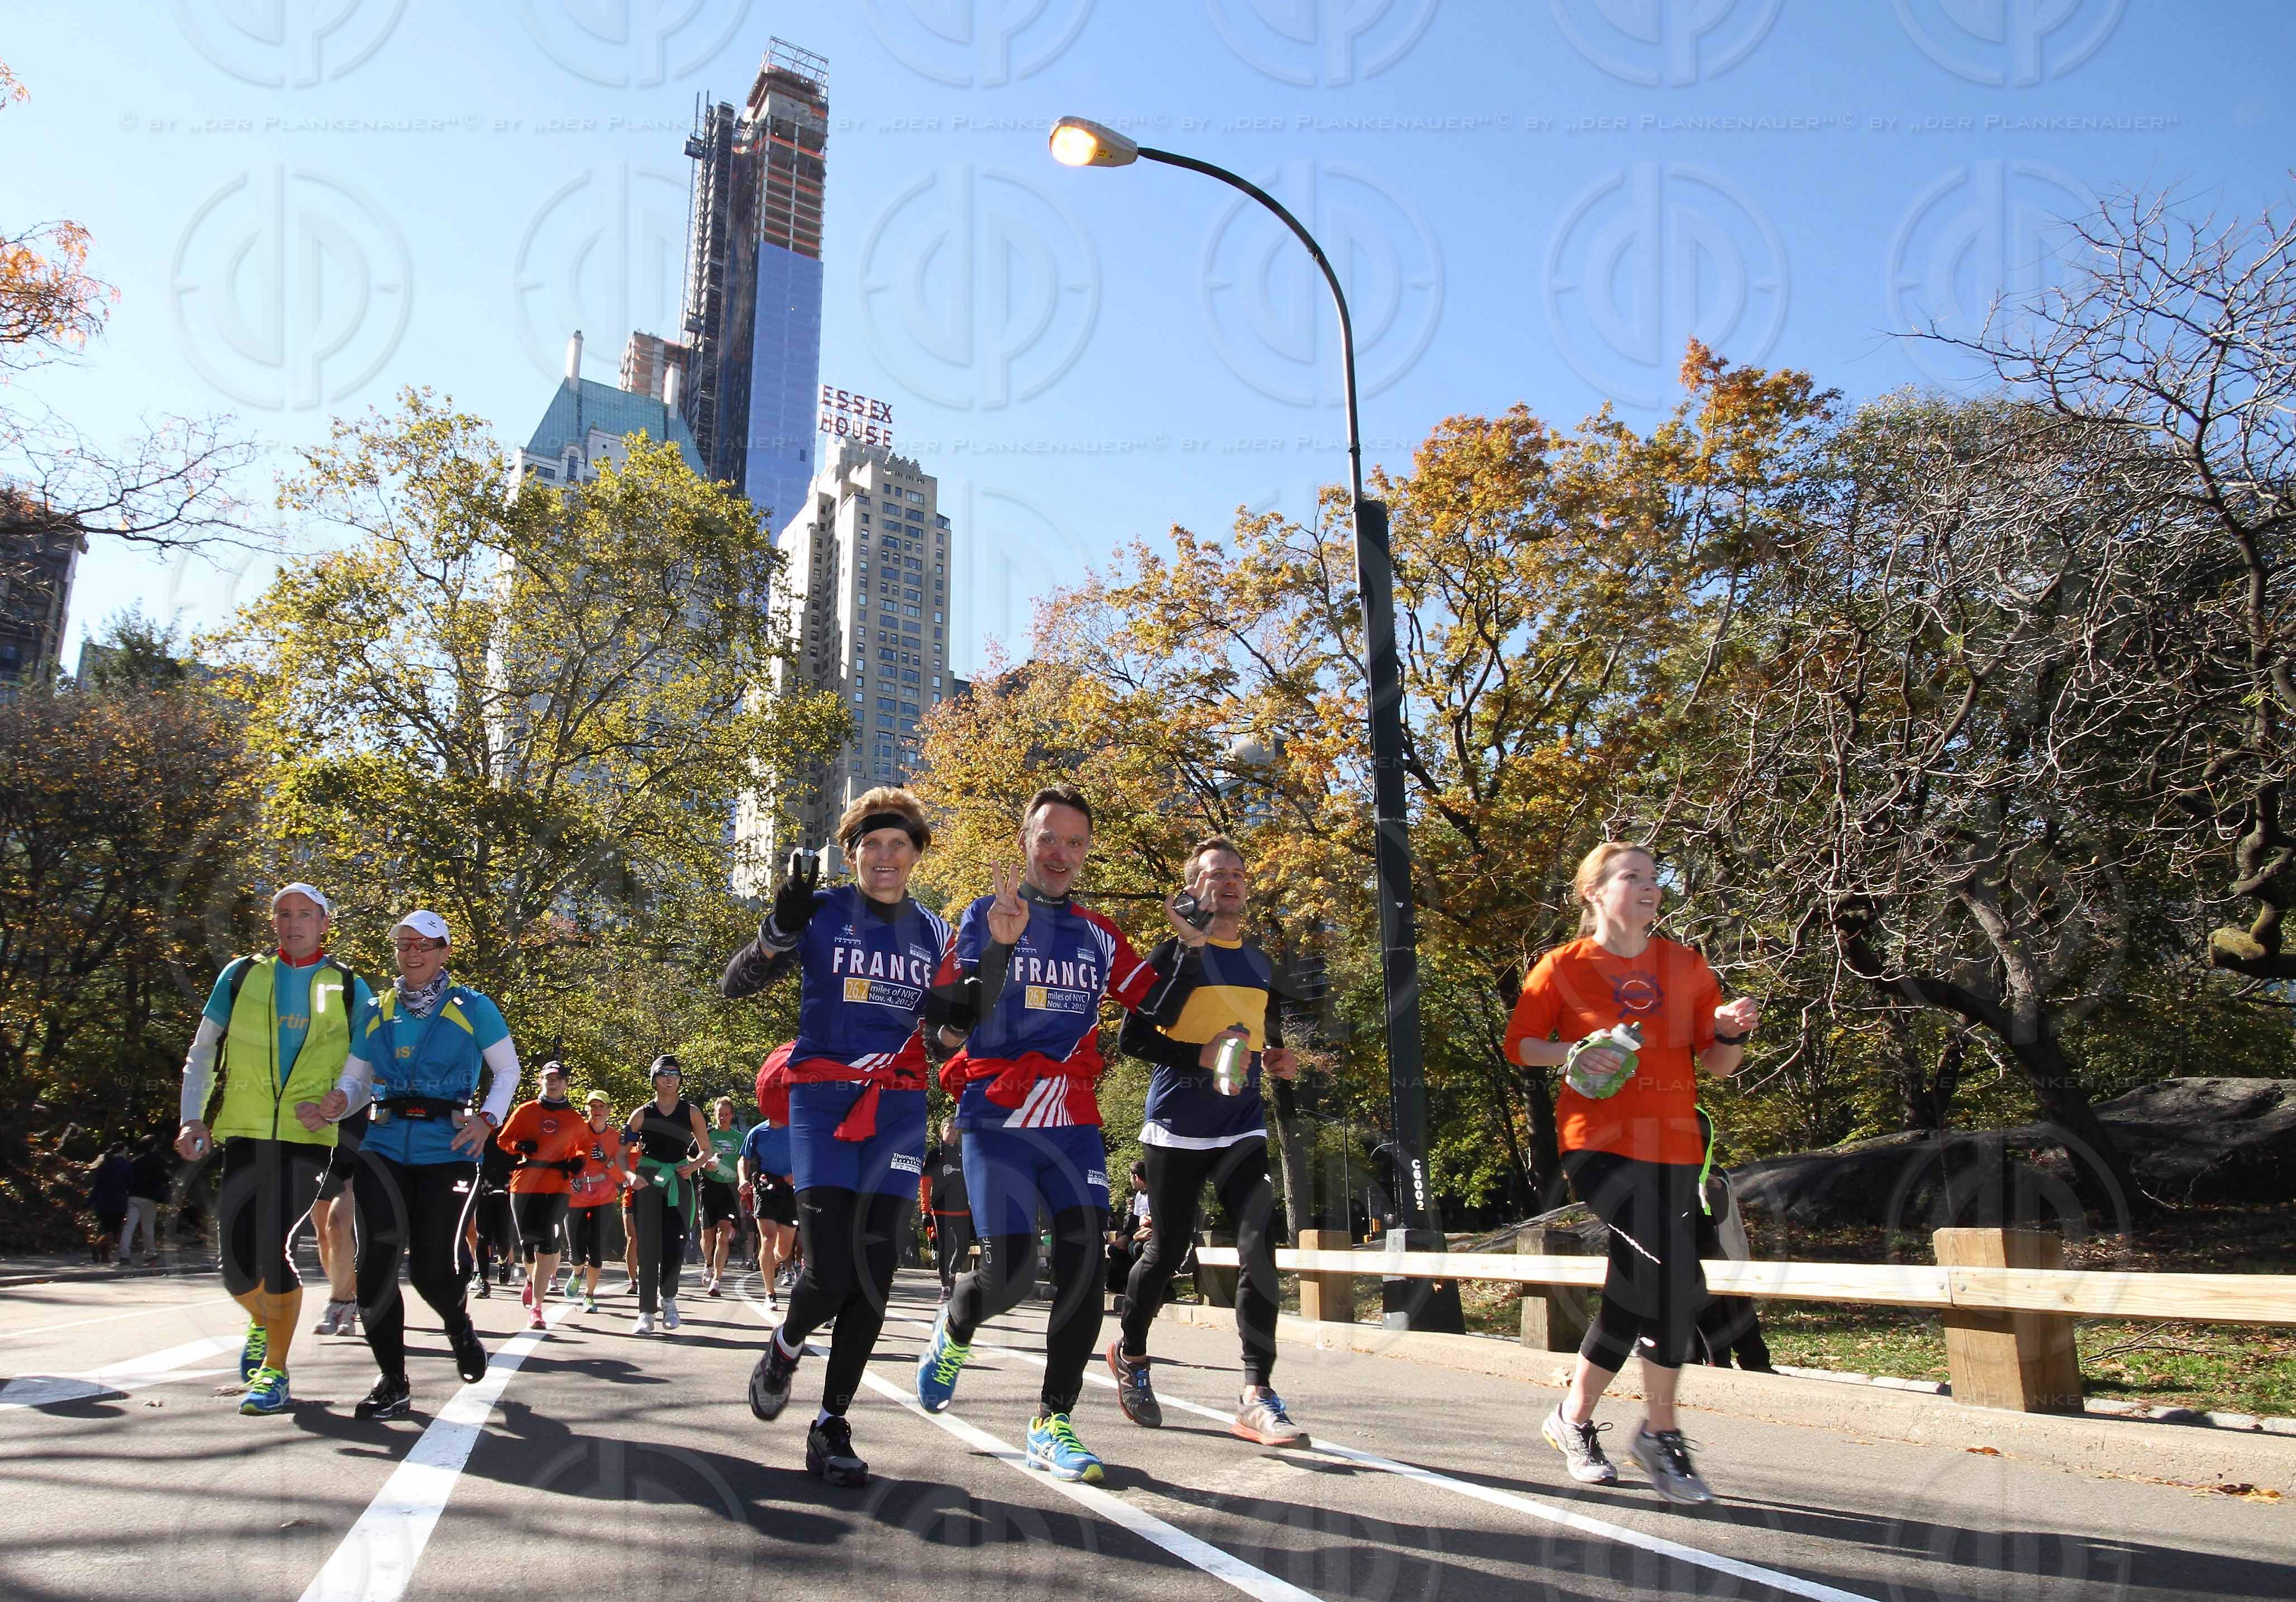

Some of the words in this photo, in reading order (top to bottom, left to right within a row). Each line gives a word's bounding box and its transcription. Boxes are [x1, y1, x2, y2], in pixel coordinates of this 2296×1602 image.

[823, 385, 893, 423] ESSEX
[820, 412, 893, 449] HOUSE
[833, 947, 932, 988] FRANCE
[1014, 956, 1098, 990] FRANCE
[846, 981, 868, 999] 26.2
[870, 985, 890, 995] miles
[892, 987, 903, 997] of
[902, 989, 918, 1000] NYC
[869, 992, 885, 1002] Nov.
[887, 996, 894, 1004] 4,
[894, 997, 914, 1007] 2012
[1047, 991, 1064, 1000] miles
[1064, 992, 1072, 1001] of
[1073, 993, 1086, 1003] NYC
[1411, 1158, 1425, 1211] C6002
